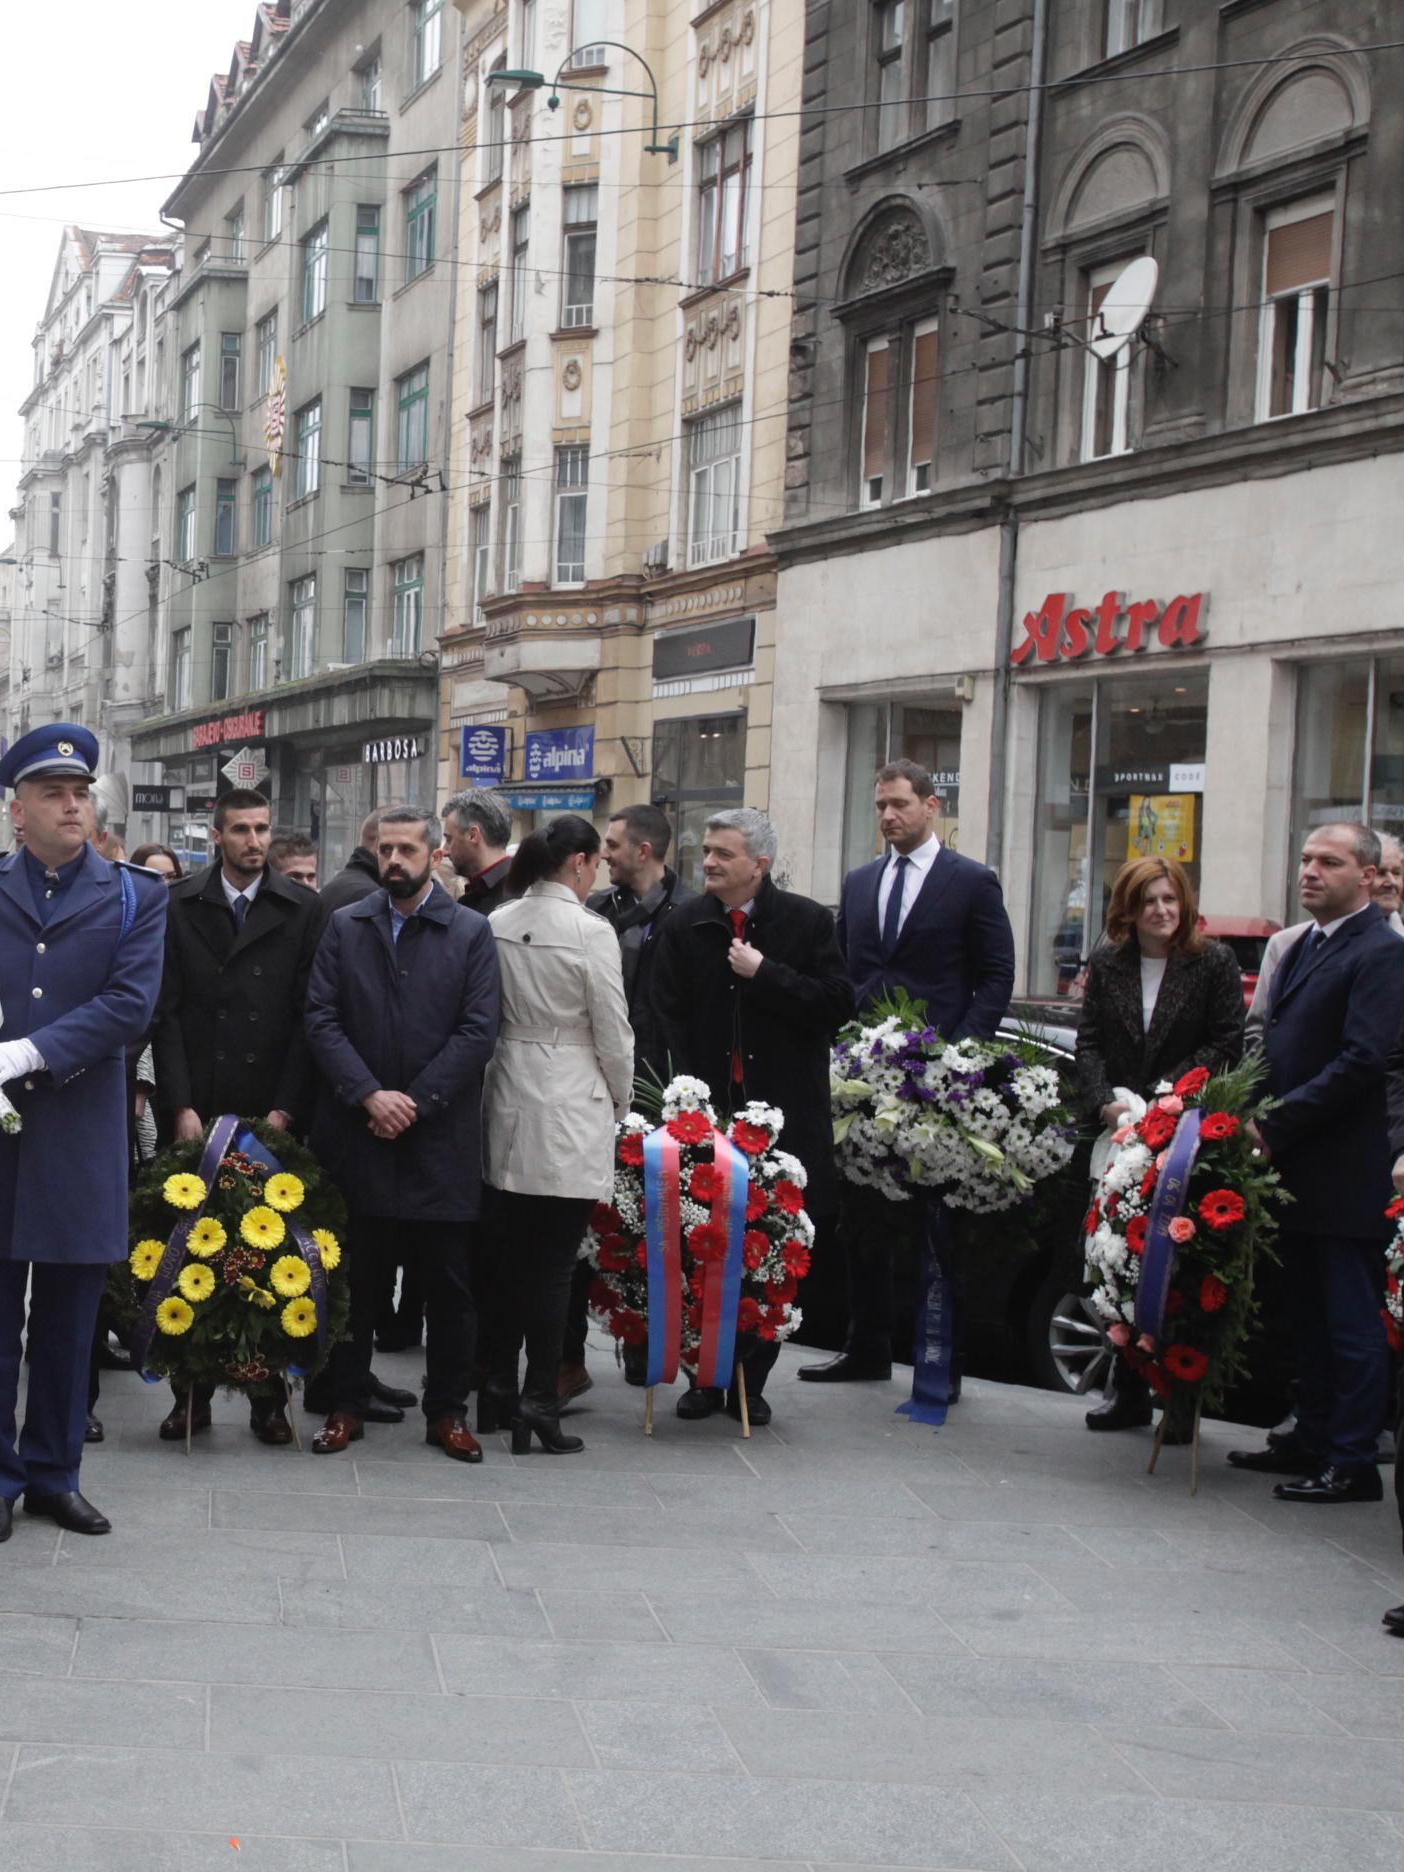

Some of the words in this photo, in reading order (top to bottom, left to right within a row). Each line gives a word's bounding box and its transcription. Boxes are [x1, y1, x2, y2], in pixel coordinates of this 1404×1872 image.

[1011, 591, 1204, 663] Astra
[366, 738, 417, 763] BARBOSA
[543, 745, 585, 771] alpina
[466, 765, 500, 774] alpina
